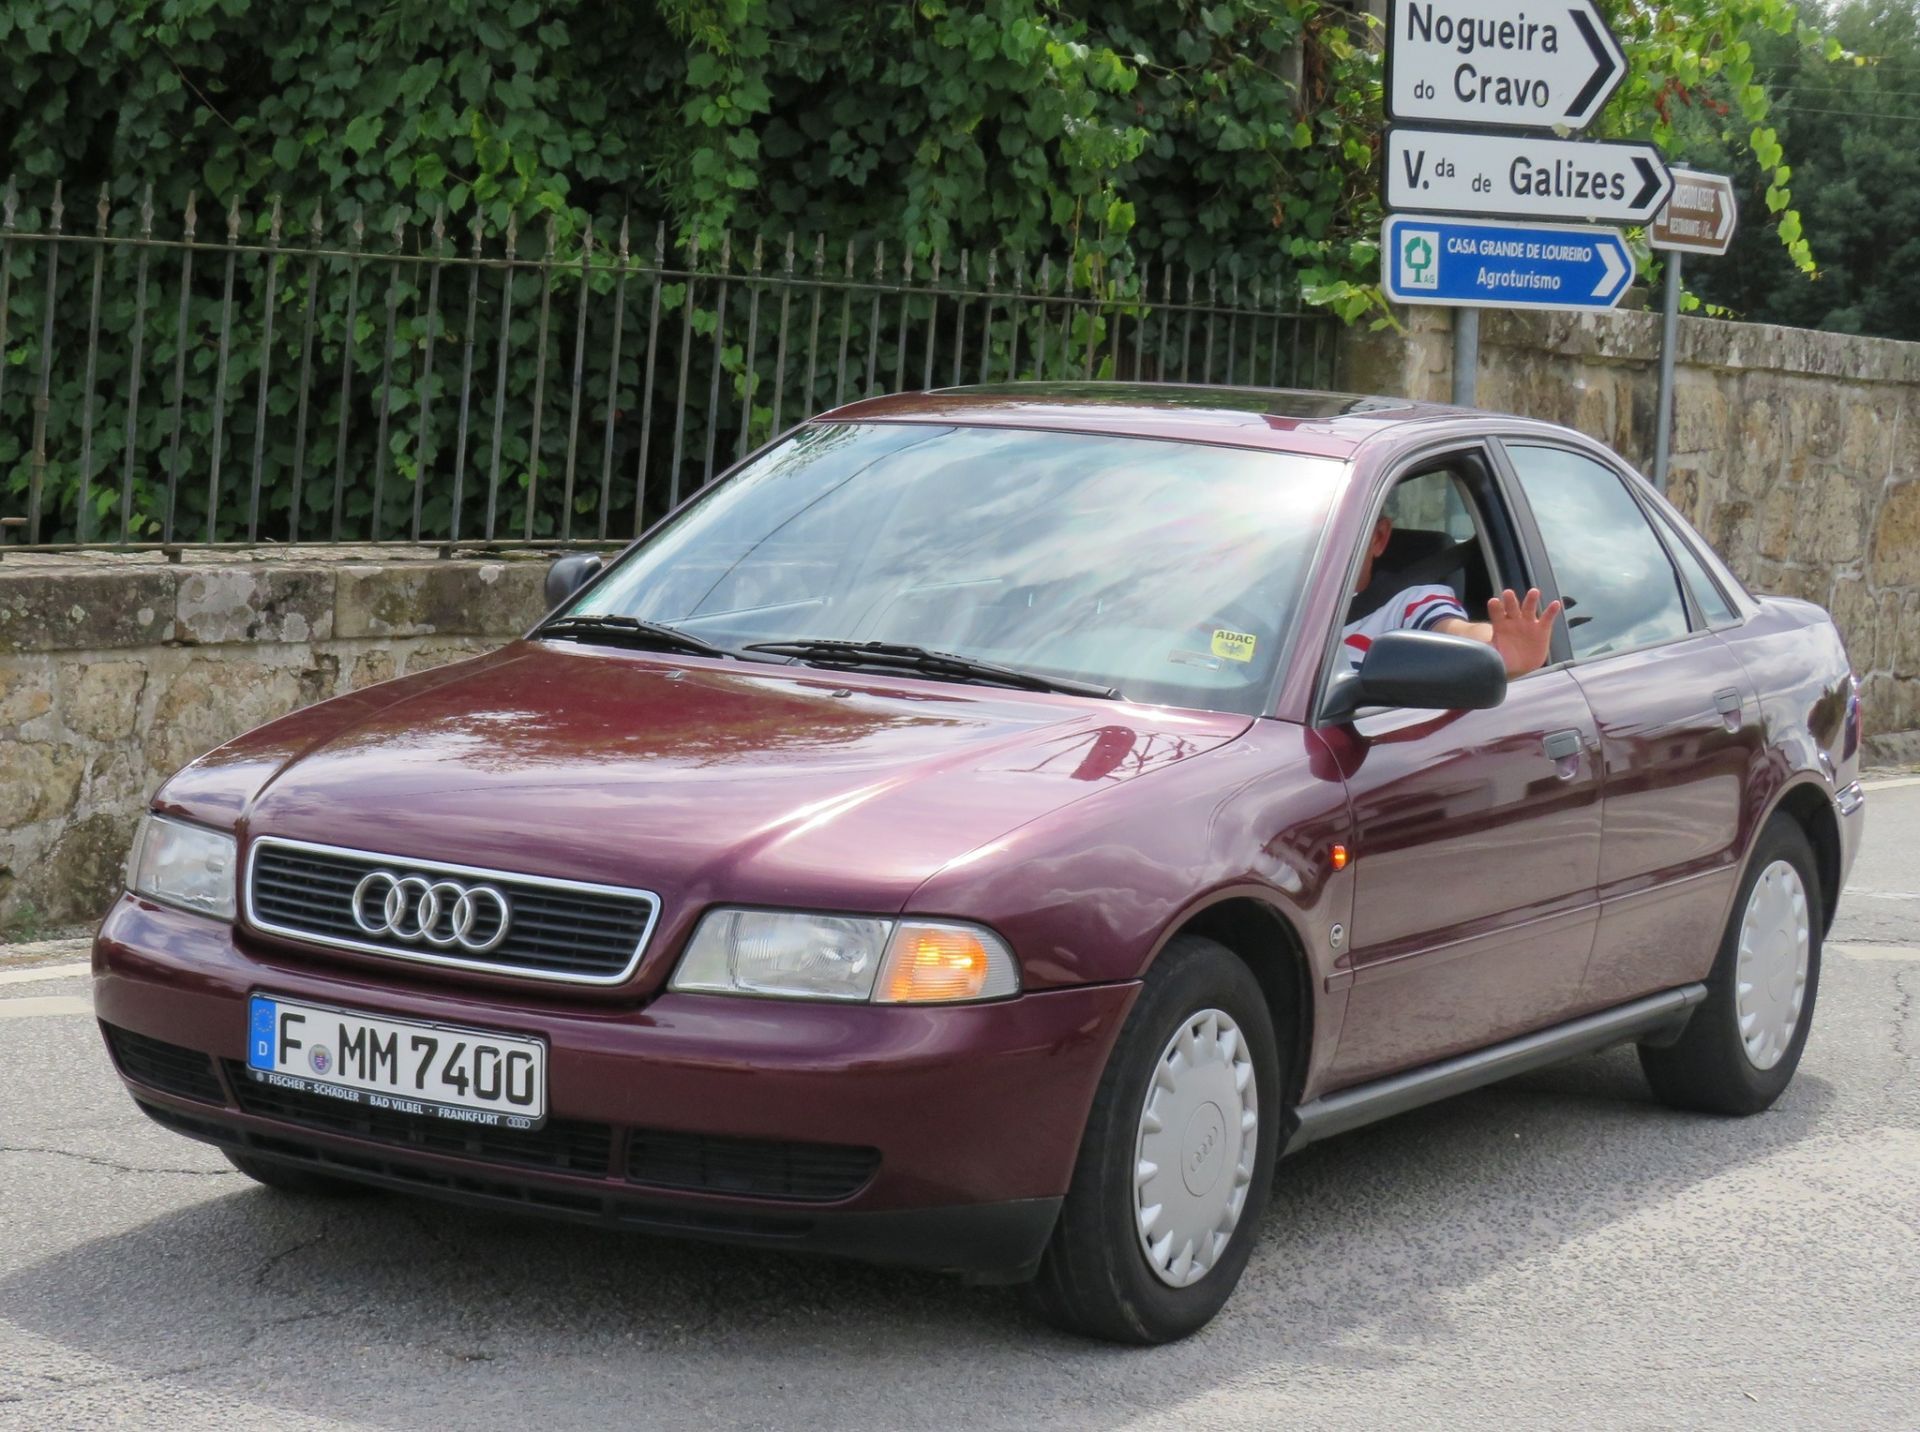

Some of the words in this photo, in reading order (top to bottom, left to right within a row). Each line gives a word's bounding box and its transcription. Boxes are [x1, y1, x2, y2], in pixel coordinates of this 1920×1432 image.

[1407, 2, 1558, 54] Nogueira
[1413, 80, 1435, 100] do
[1454, 62, 1550, 108] Cravo
[1472, 173, 1492, 193] de
[1509, 156, 1625, 201] Galizes
[1447, 237, 1477, 255] CASA
[1480, 240, 1524, 258] GRANDE
[1526, 243, 1541, 259] DE
[1542, 244, 1592, 262] LOUREIRO
[1423, 274, 1435, 285] AG
[1476, 266, 1561, 290] Agroturismo
[1215, 631, 1254, 645] ADAC
[258, 1040, 268, 1056] D
[279, 1012, 306, 1065] F
[268, 1074, 305, 1091] FISCHER
[369, 1095, 390, 1109] BAD
[391, 1099, 424, 1115] VILBEL
[438, 1107, 500, 1126] FRANKFURT
